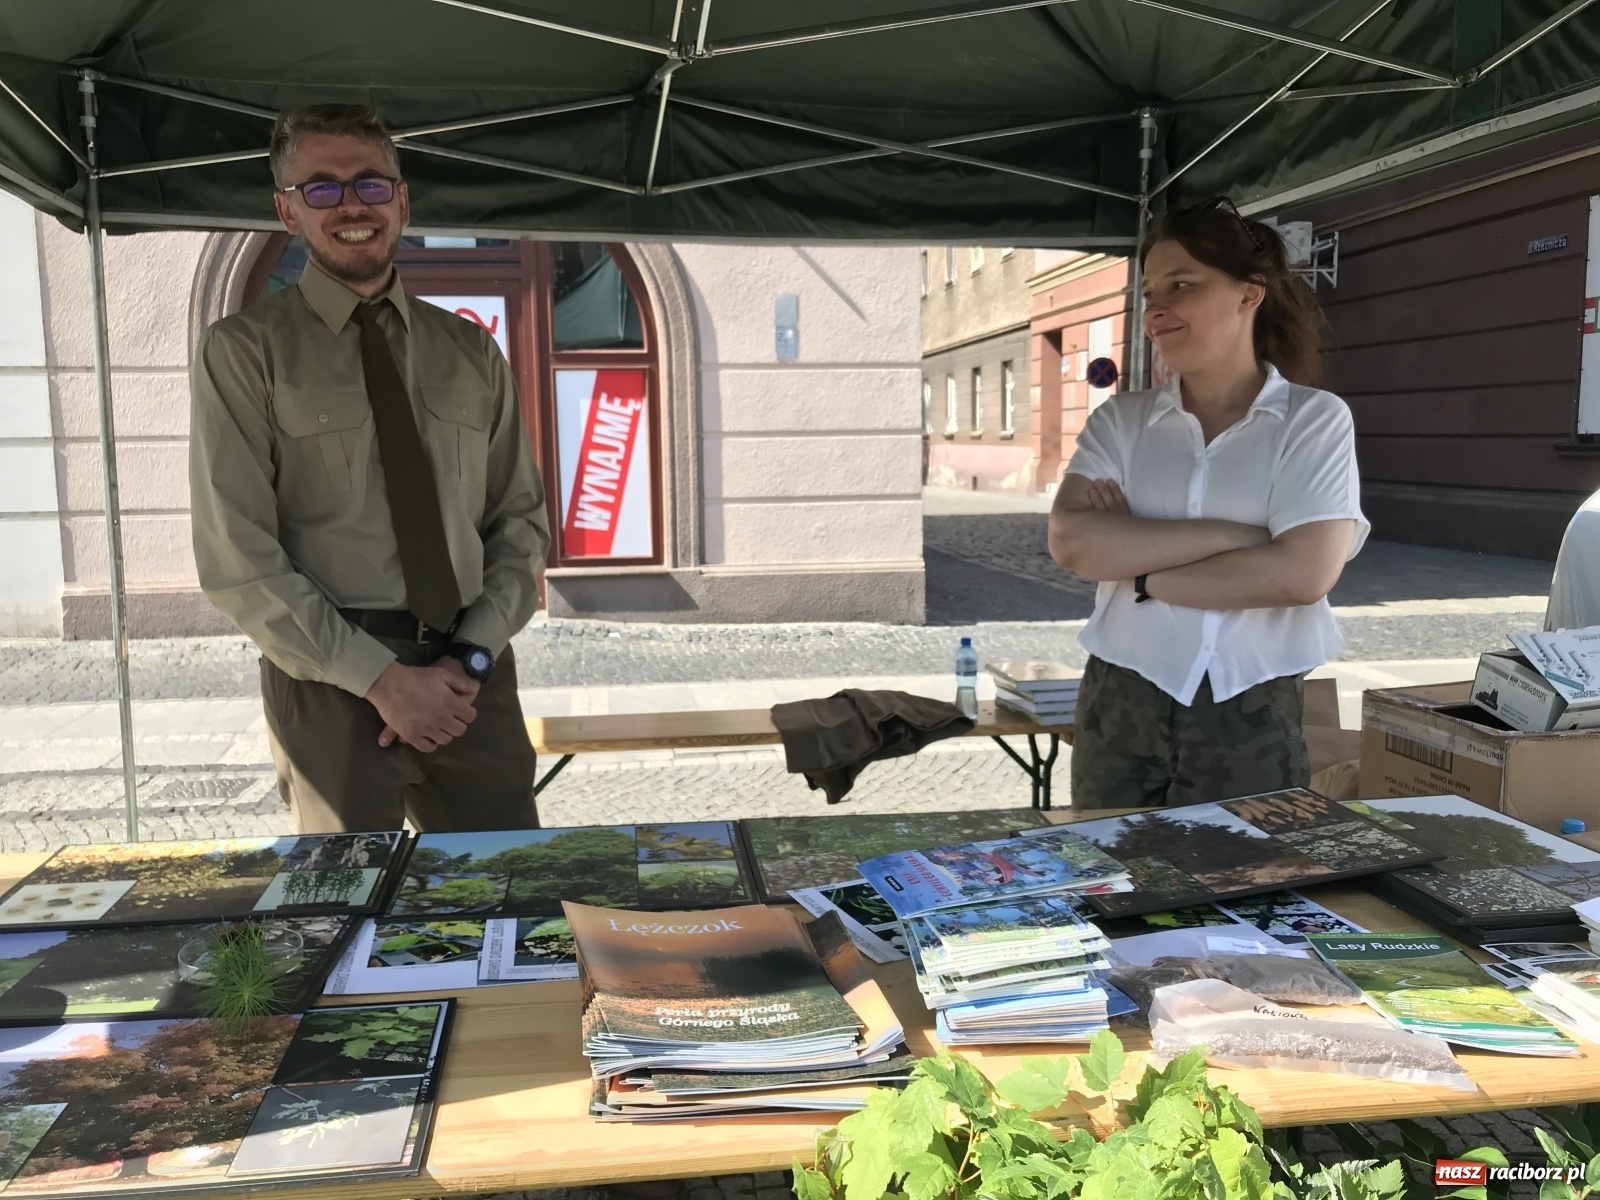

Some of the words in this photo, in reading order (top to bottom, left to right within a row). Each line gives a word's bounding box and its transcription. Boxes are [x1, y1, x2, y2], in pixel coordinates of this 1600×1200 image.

[573, 392, 643, 532] WYNAJMĘ
[606, 918, 744, 936] Łężczok
[1326, 943, 1366, 951] Lasy
[1370, 942, 1440, 951] Rudzkie
[655, 1006, 704, 1018] Perła
[705, 1002, 790, 1018] przyrody
[658, 1015, 734, 1029] Górnego
[739, 1010, 800, 1027] Śląska
